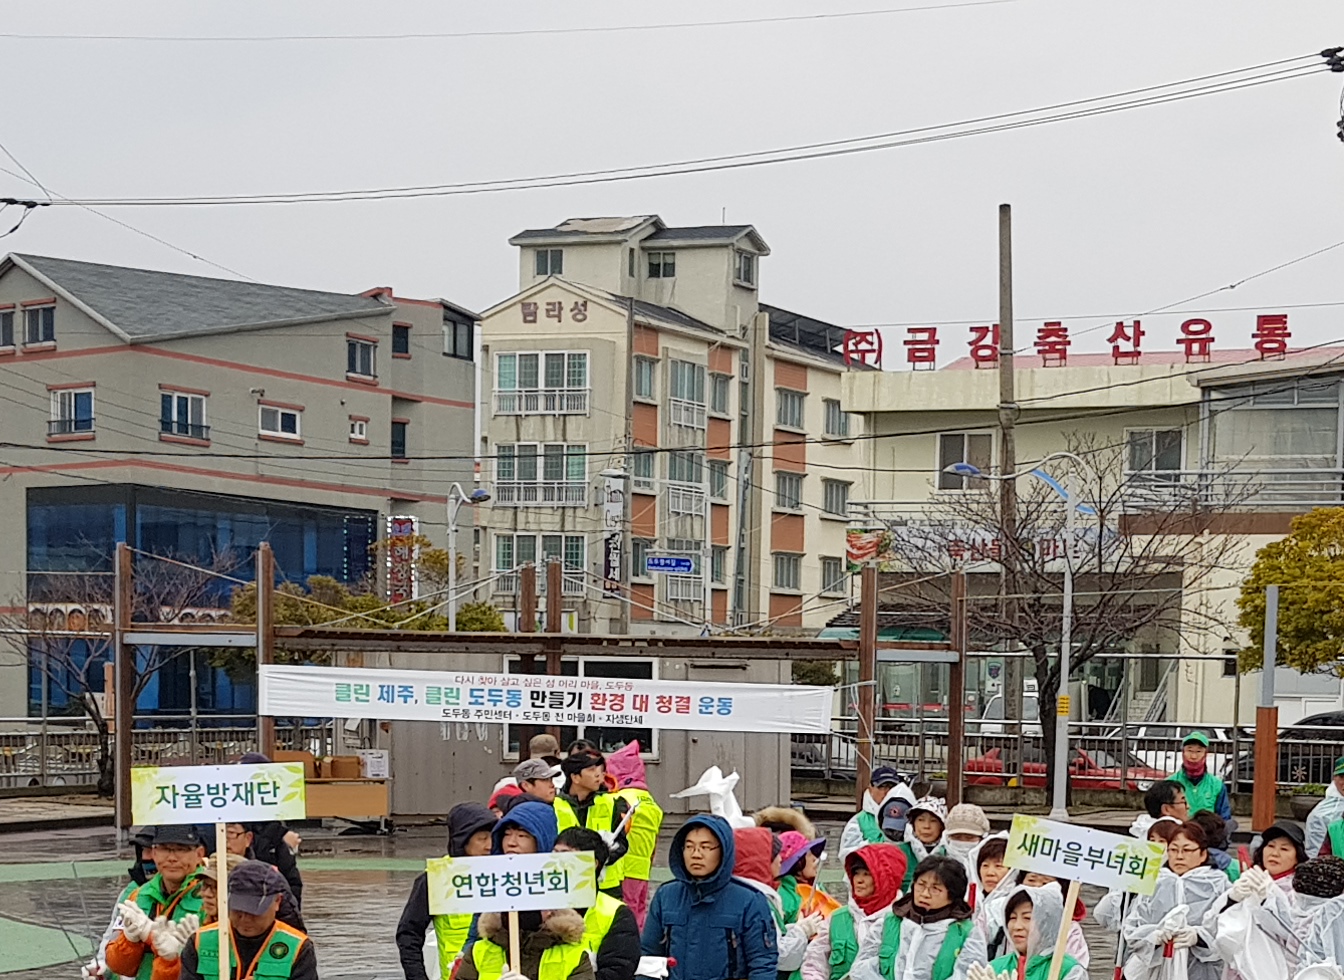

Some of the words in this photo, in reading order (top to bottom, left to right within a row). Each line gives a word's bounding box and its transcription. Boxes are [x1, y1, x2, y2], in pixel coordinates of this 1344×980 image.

[520, 300, 589, 324] 탐라성
[455, 675, 474, 685] 다시
[478, 676, 497, 686] 찾아
[501, 677, 520, 687] 살고
[522, 678, 542, 688] 싶은
[545, 678, 555, 688] 섬
[559, 679, 578, 689] 머리
[605, 681, 635, 691] 도두동
[335, 682, 370, 703] 클린
[377, 684, 418, 705] 제주,
[425, 685, 461, 706] 클린
[468, 687, 522, 708] 도두동
[530, 690, 583, 710] 만들기
[590, 693, 625, 712] 환경
[632, 694, 649, 713] 대
[656, 695, 691, 714] 청결
[698, 696, 733, 716] 운동
[441, 708, 471, 719] 도두동
[474, 710, 512, 720] 주민센터
[522, 711, 550, 721] 도두동
[567, 713, 595, 723] 마을회
[605, 714, 643, 725] 자생단체
[155, 781, 281, 810] 자율방재단
[1017, 833, 1148, 880] 새마을부녀회
[452, 869, 569, 899] 연합청년회
